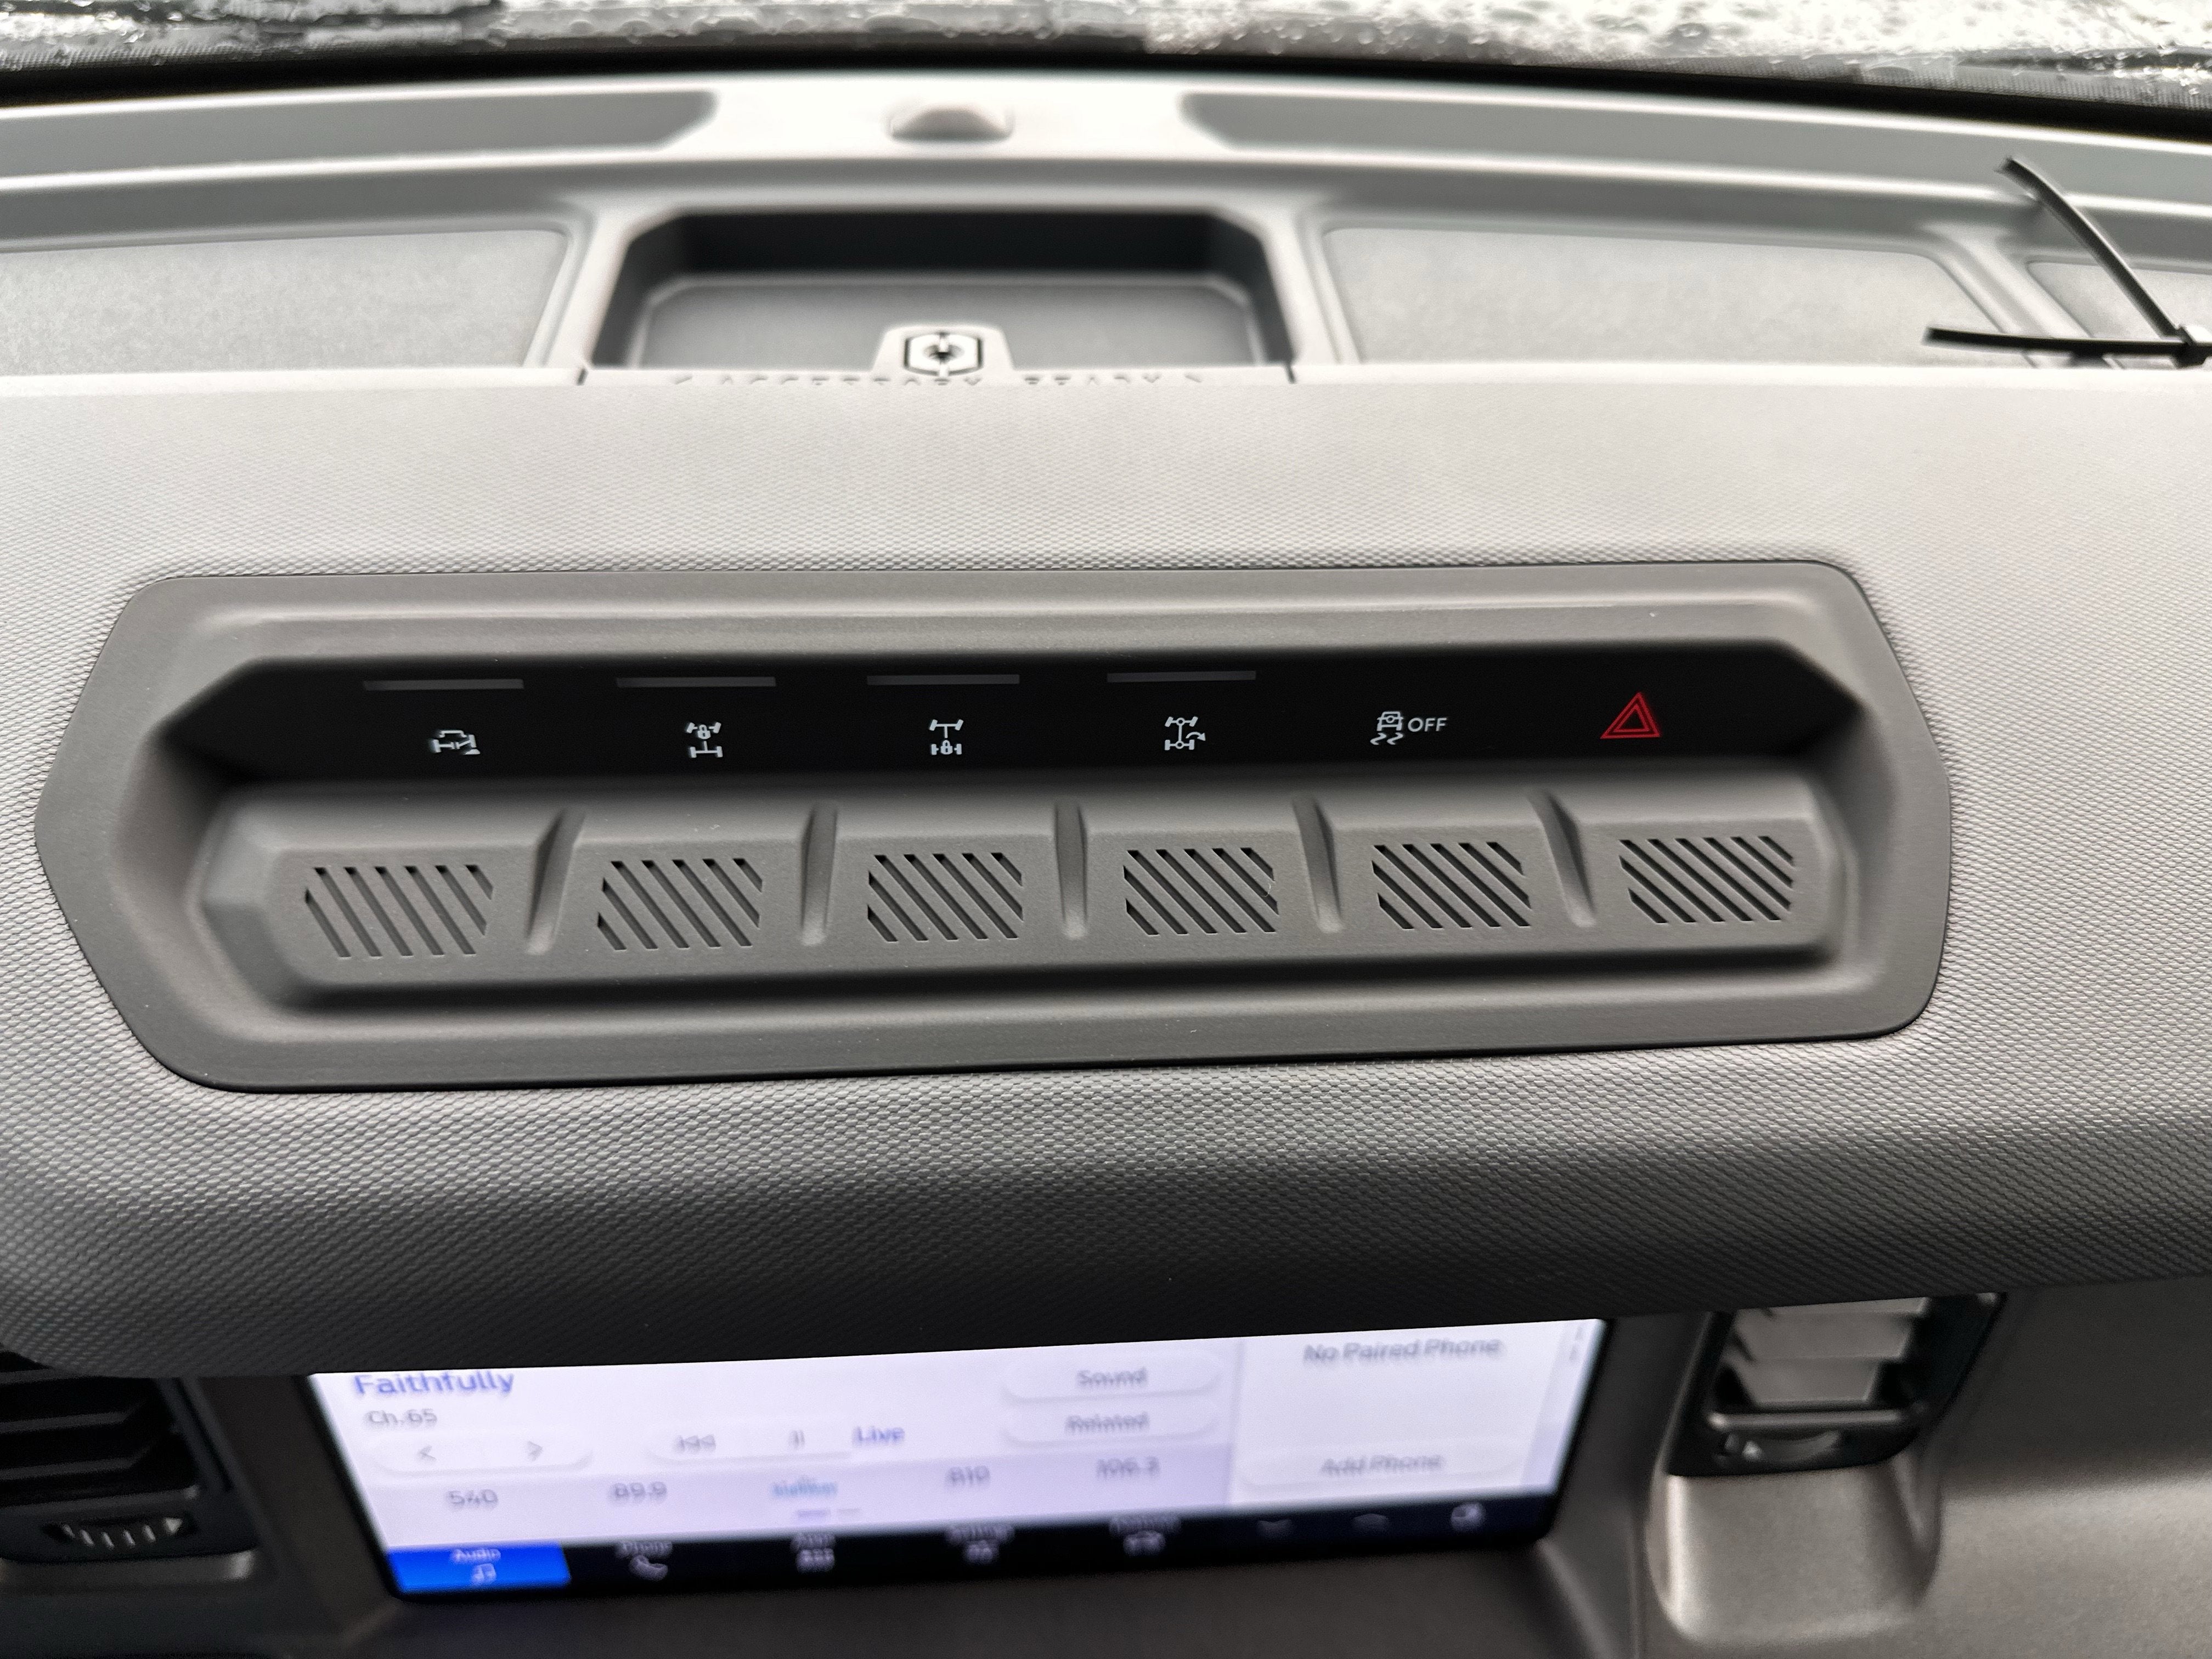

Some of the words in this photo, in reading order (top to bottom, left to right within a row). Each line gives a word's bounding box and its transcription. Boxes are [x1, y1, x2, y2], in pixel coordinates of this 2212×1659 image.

[1408, 718, 1447, 732] OFF
[1303, 1343, 1337, 1364] No
[1343, 1340, 1419, 1361] Paired
[1425, 1337, 1502, 1357] Phone
[354, 1370, 515, 1397] Faithfully
[1076, 1367, 1148, 1387] Sound
[366, 1409, 438, 1427] Ch.65
[1065, 1411, 1150, 1433] Related
[853, 1426, 905, 1446] Live
[1320, 1457, 1364, 1477] Add
[1370, 1454, 1444, 1475] Phone
